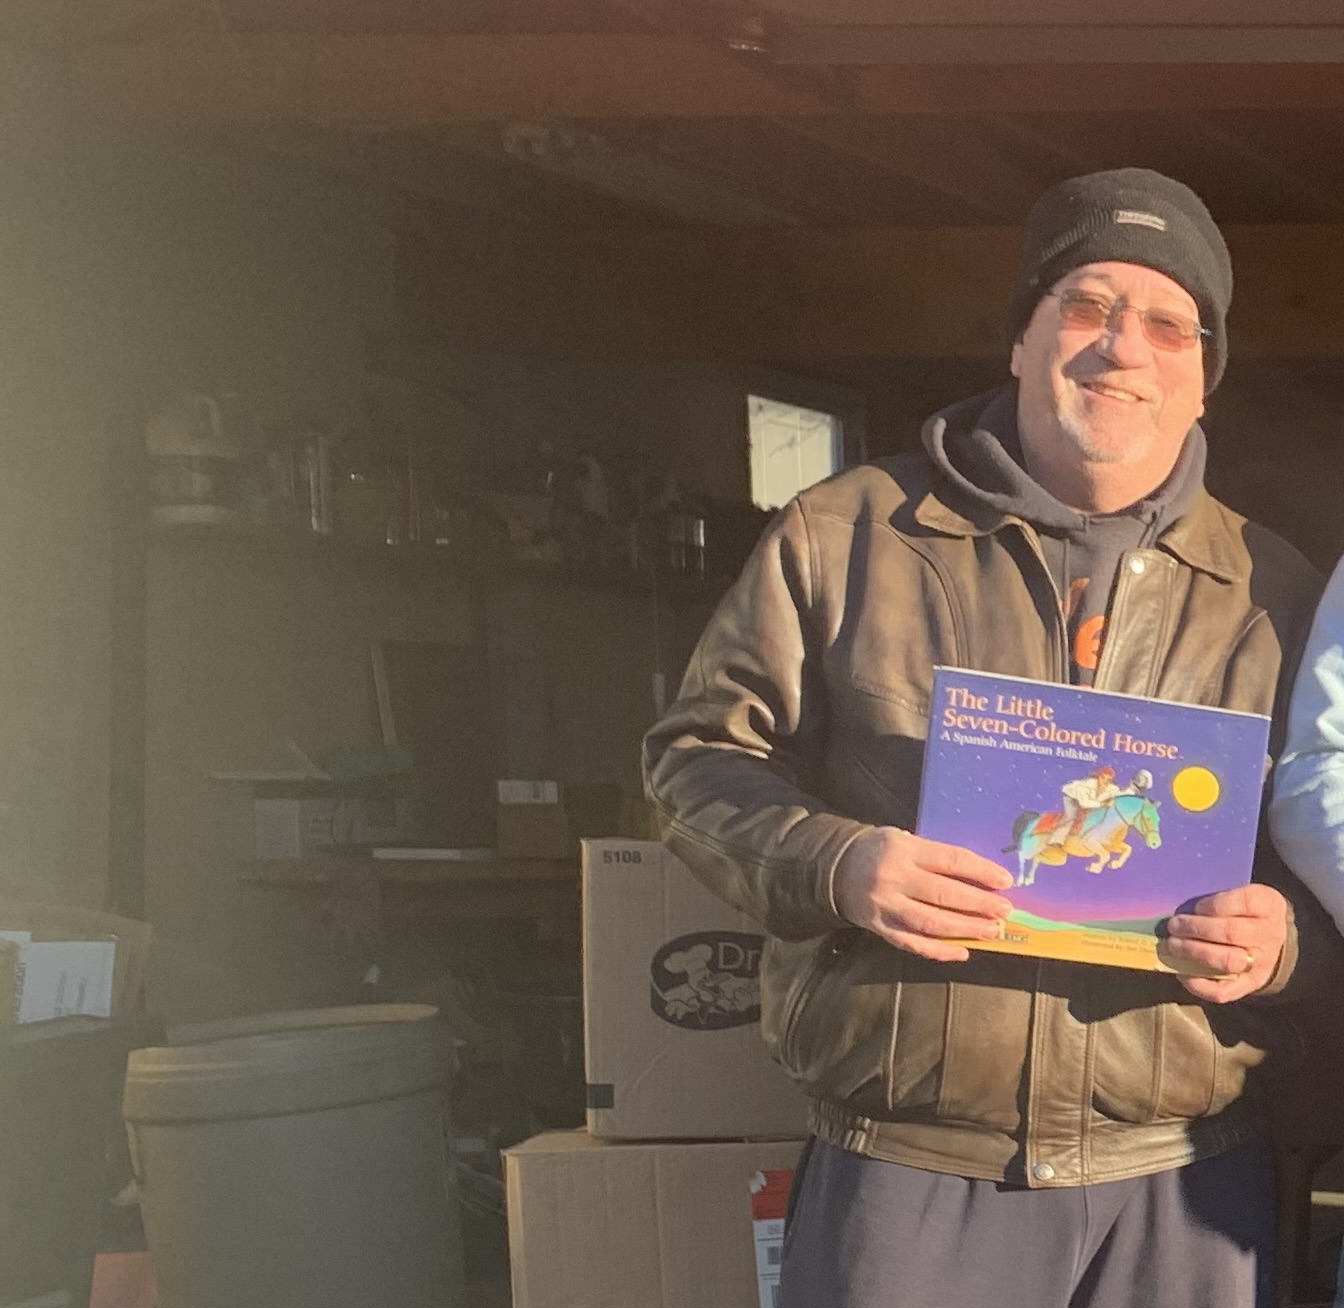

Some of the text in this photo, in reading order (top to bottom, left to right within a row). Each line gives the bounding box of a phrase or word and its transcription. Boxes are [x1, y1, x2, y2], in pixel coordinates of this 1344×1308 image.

[945, 687, 1053, 720] The Little
[941, 732, 1098, 762] A Spanish American Folktale
[943, 709, 1179, 760] Seven-Colored Horse
[603, 851, 642, 864] 5108
